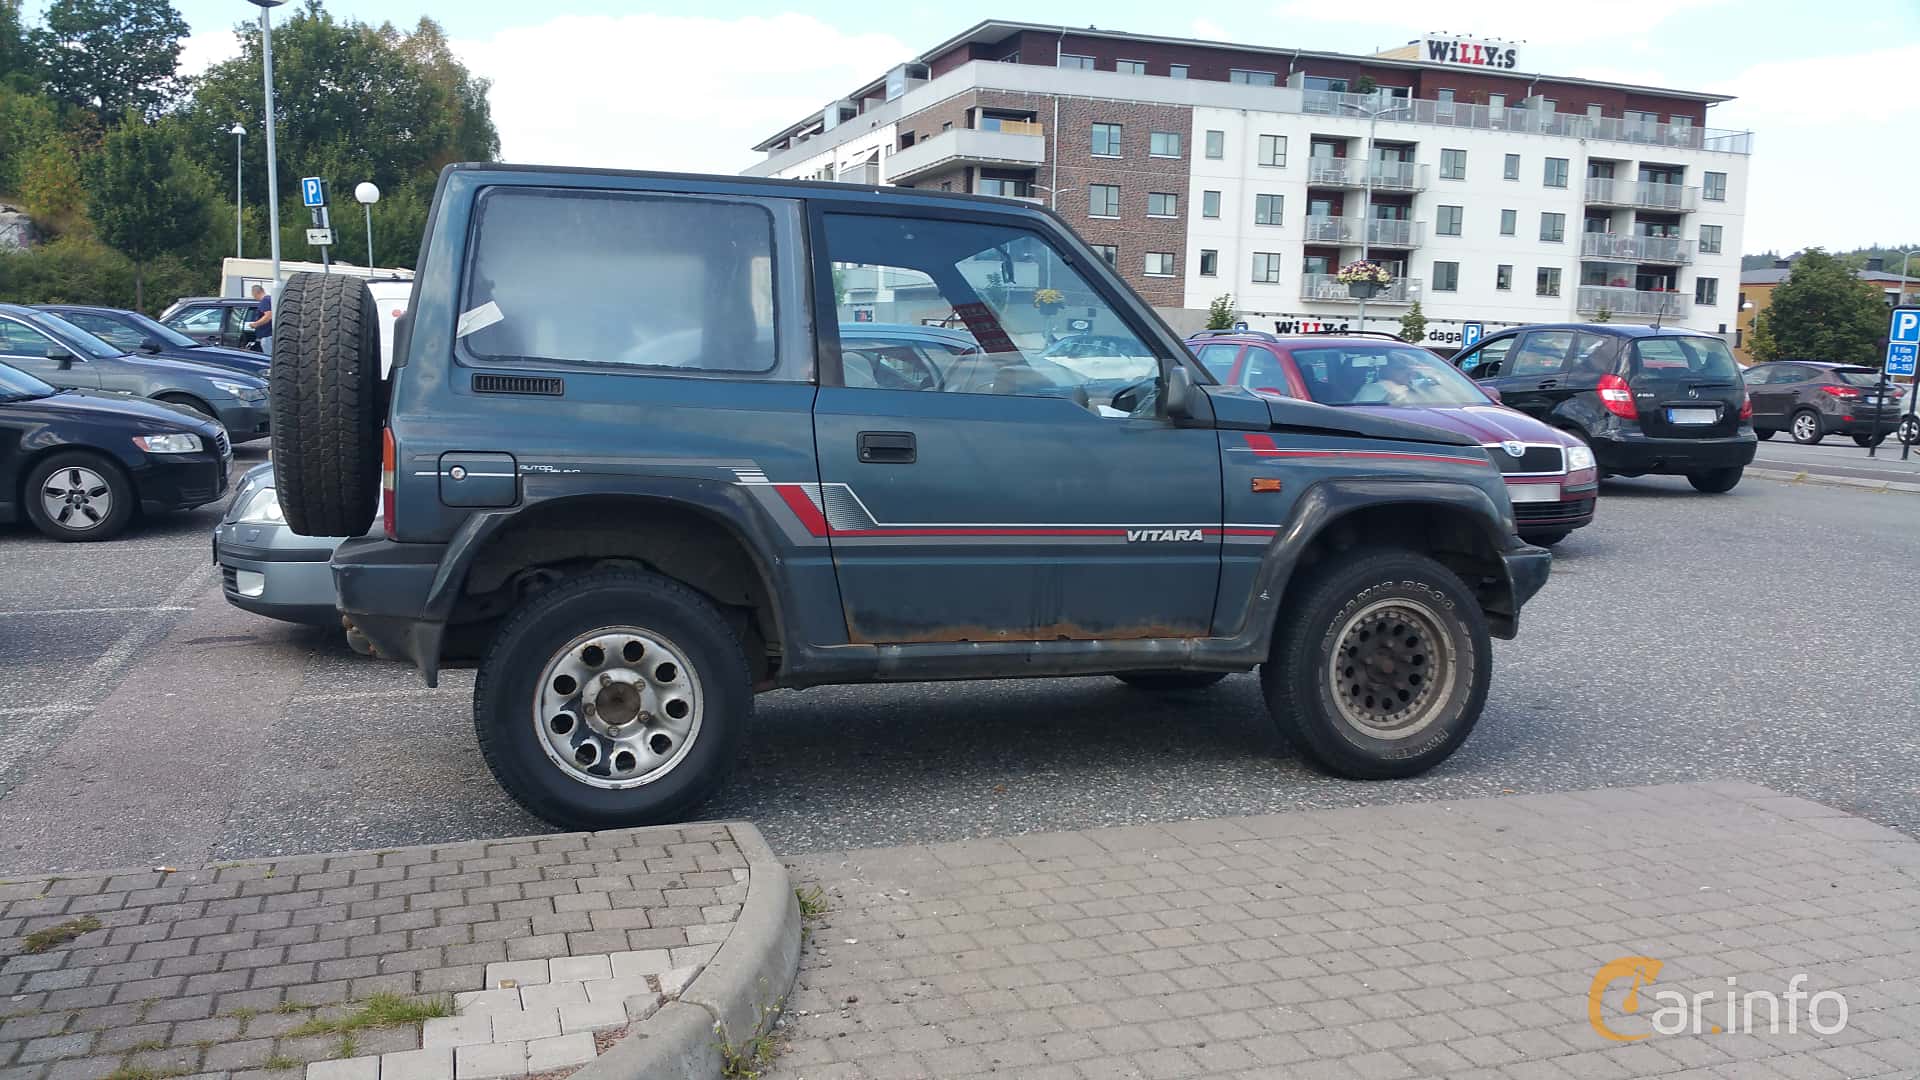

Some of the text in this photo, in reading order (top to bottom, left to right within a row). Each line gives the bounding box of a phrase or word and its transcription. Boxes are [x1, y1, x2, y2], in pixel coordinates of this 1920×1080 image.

[307, 181, 317, 203] P
[1428, 328, 1463, 343] daga
[1466, 326, 1478, 345] P
[1897, 313, 1918, 339] P
[1127, 529, 1203, 541] VITARA
